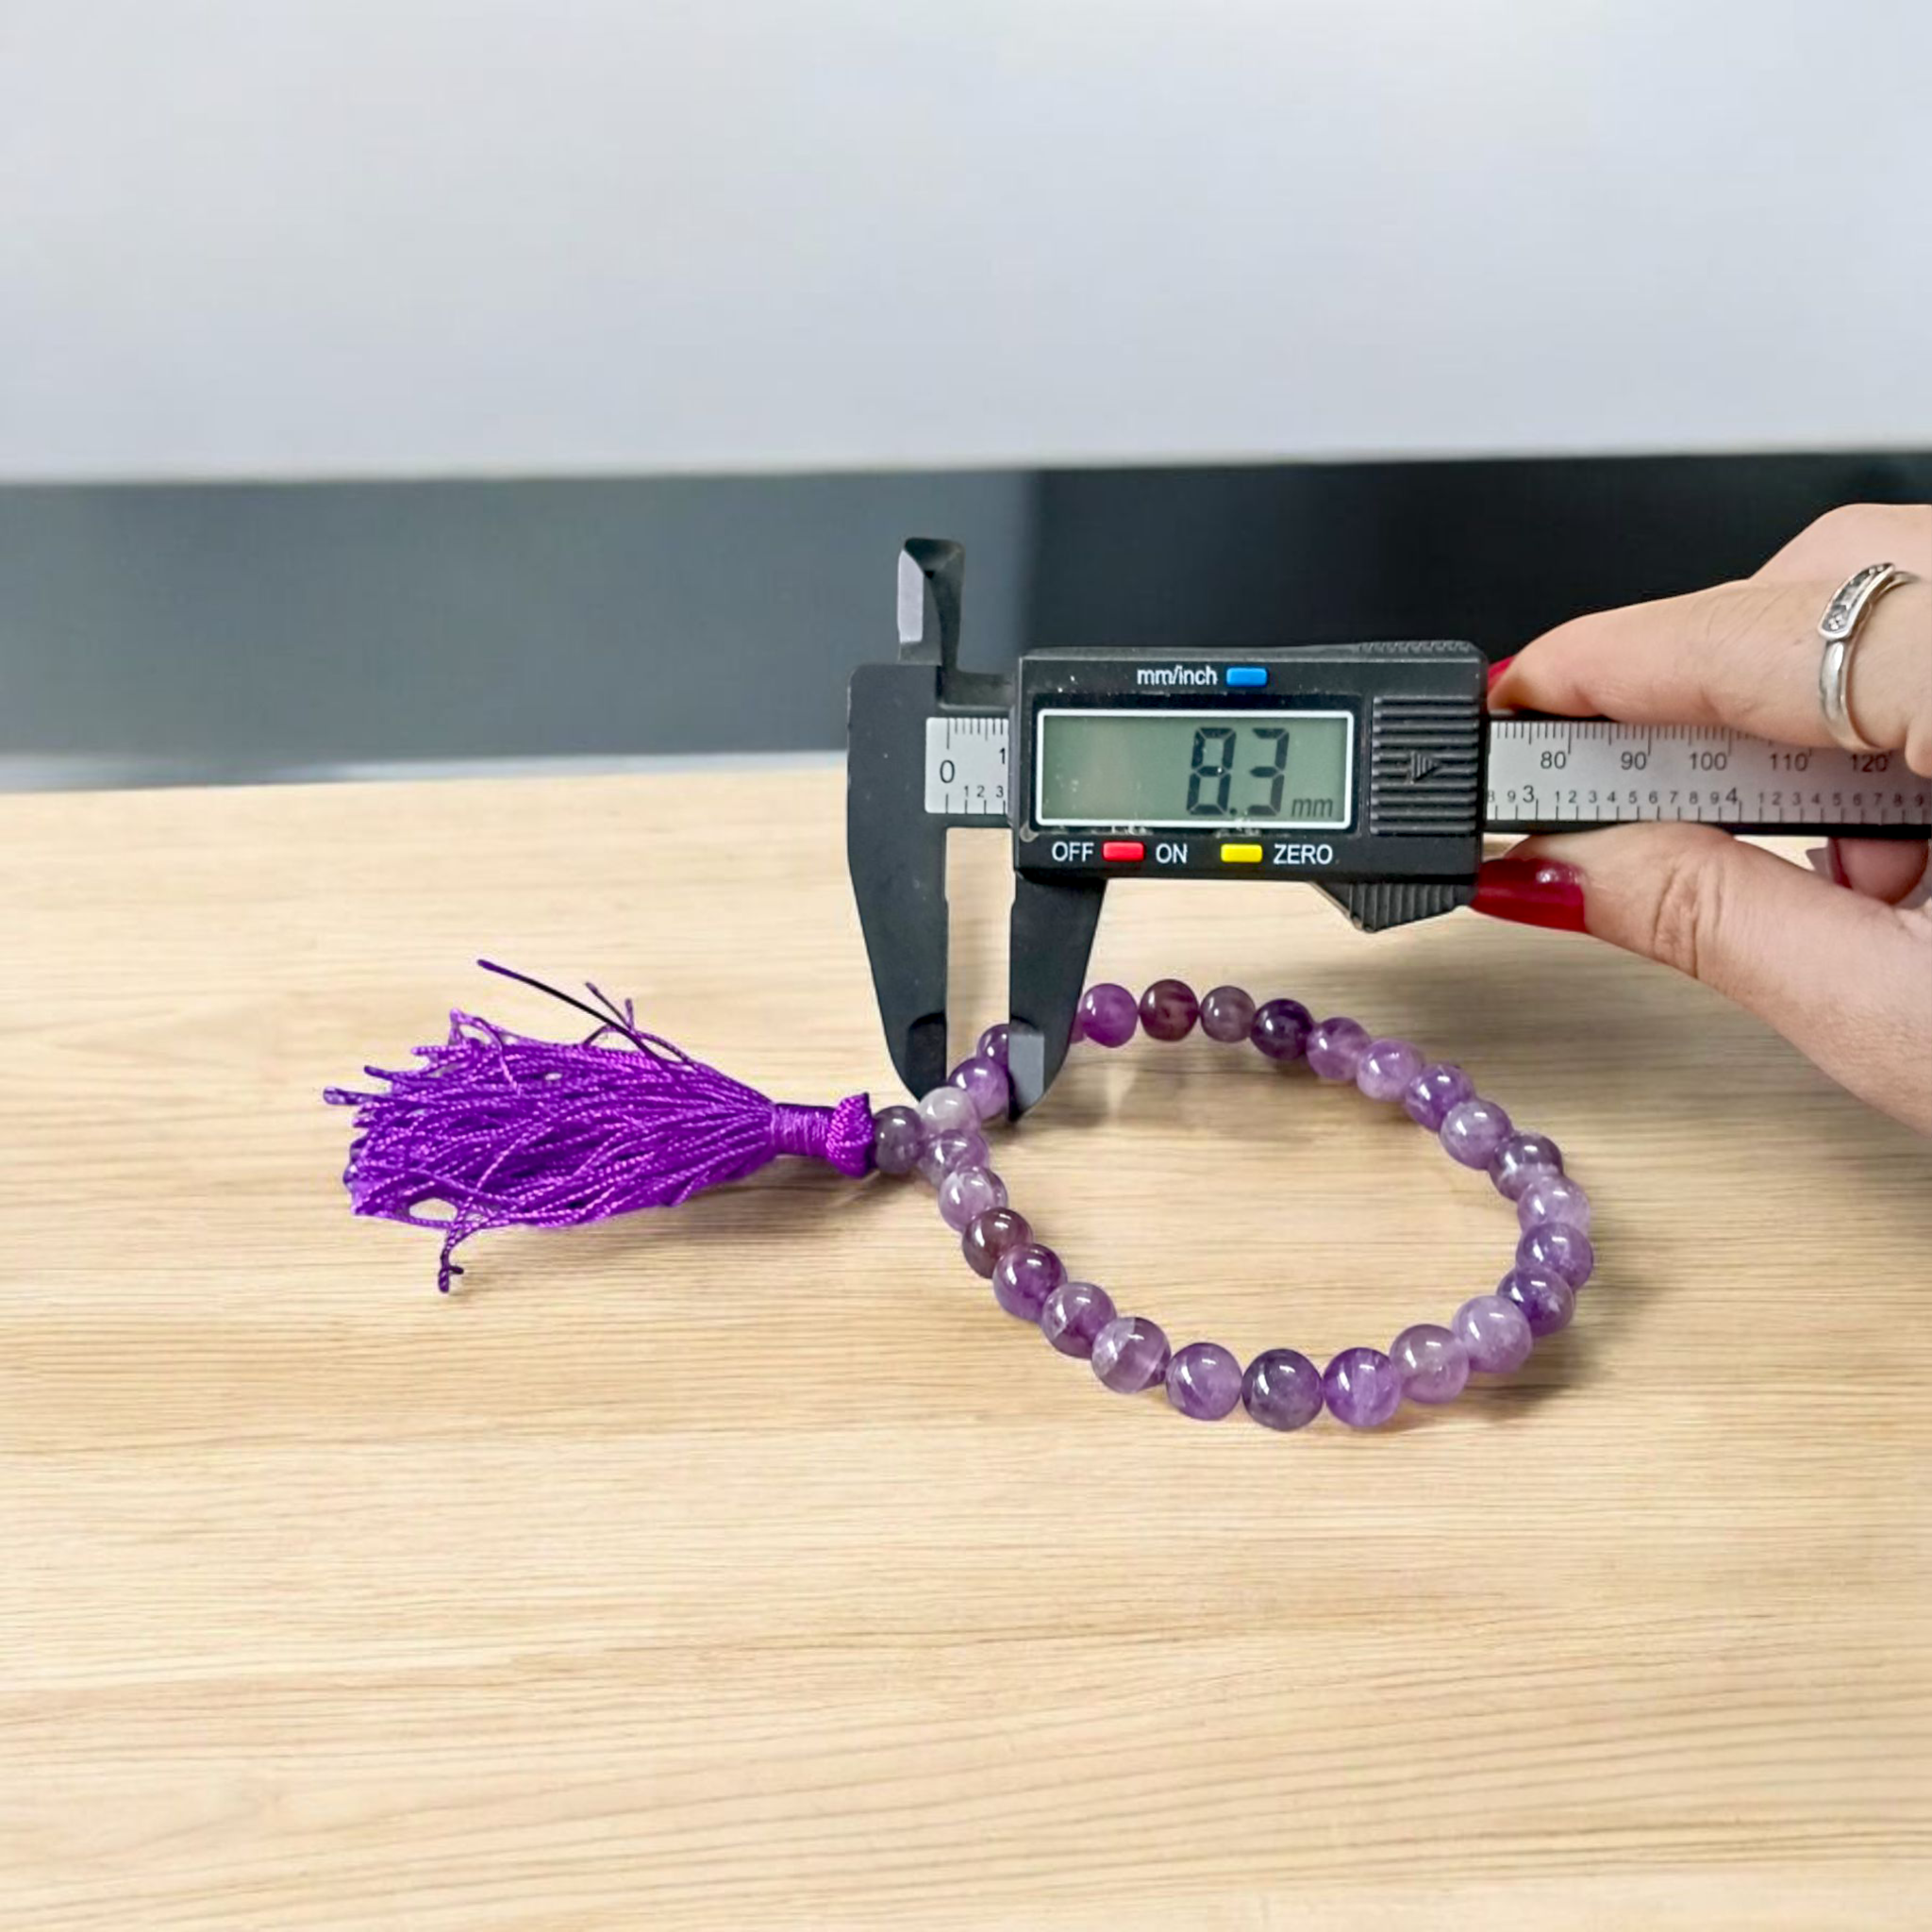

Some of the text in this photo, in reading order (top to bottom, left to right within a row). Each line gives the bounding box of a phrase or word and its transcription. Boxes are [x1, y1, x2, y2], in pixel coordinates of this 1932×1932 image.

[1137, 665, 1218, 687] mm/inch
[940, 759, 956, 784] 0
[1186, 726, 1333, 818] 8.3 mm
[1540, 751, 1889, 773] 80 90 100 110 120
[964, 785, 1005, 799] 1 2 3
[1507, 790, 1517, 803] 9
[1523, 784, 1535, 804] 3
[1568, 790, 1577, 804] 2
[1589, 790, 1598, 804] 3
[1607, 791, 1616, 803] 4
[1628, 791, 1638, 805] 5
[1648, 791, 1658, 805] 6
[1670, 791, 1679, 805] 7
[1689, 791, 1699, 805] 8
[1709, 791, 1720, 805] 9
[1724, 786, 1739, 805] 4
[1772, 791, 1782, 806] 2
[1792, 791, 1802, 806] 3
[1811, 792, 1821, 805] 4
[1833, 792, 1842, 807] 5
[1853, 792, 1862, 807] 6
[1874, 792, 1883, 807] 7
[1051, 841, 1334, 865] OFF ON ZERO
